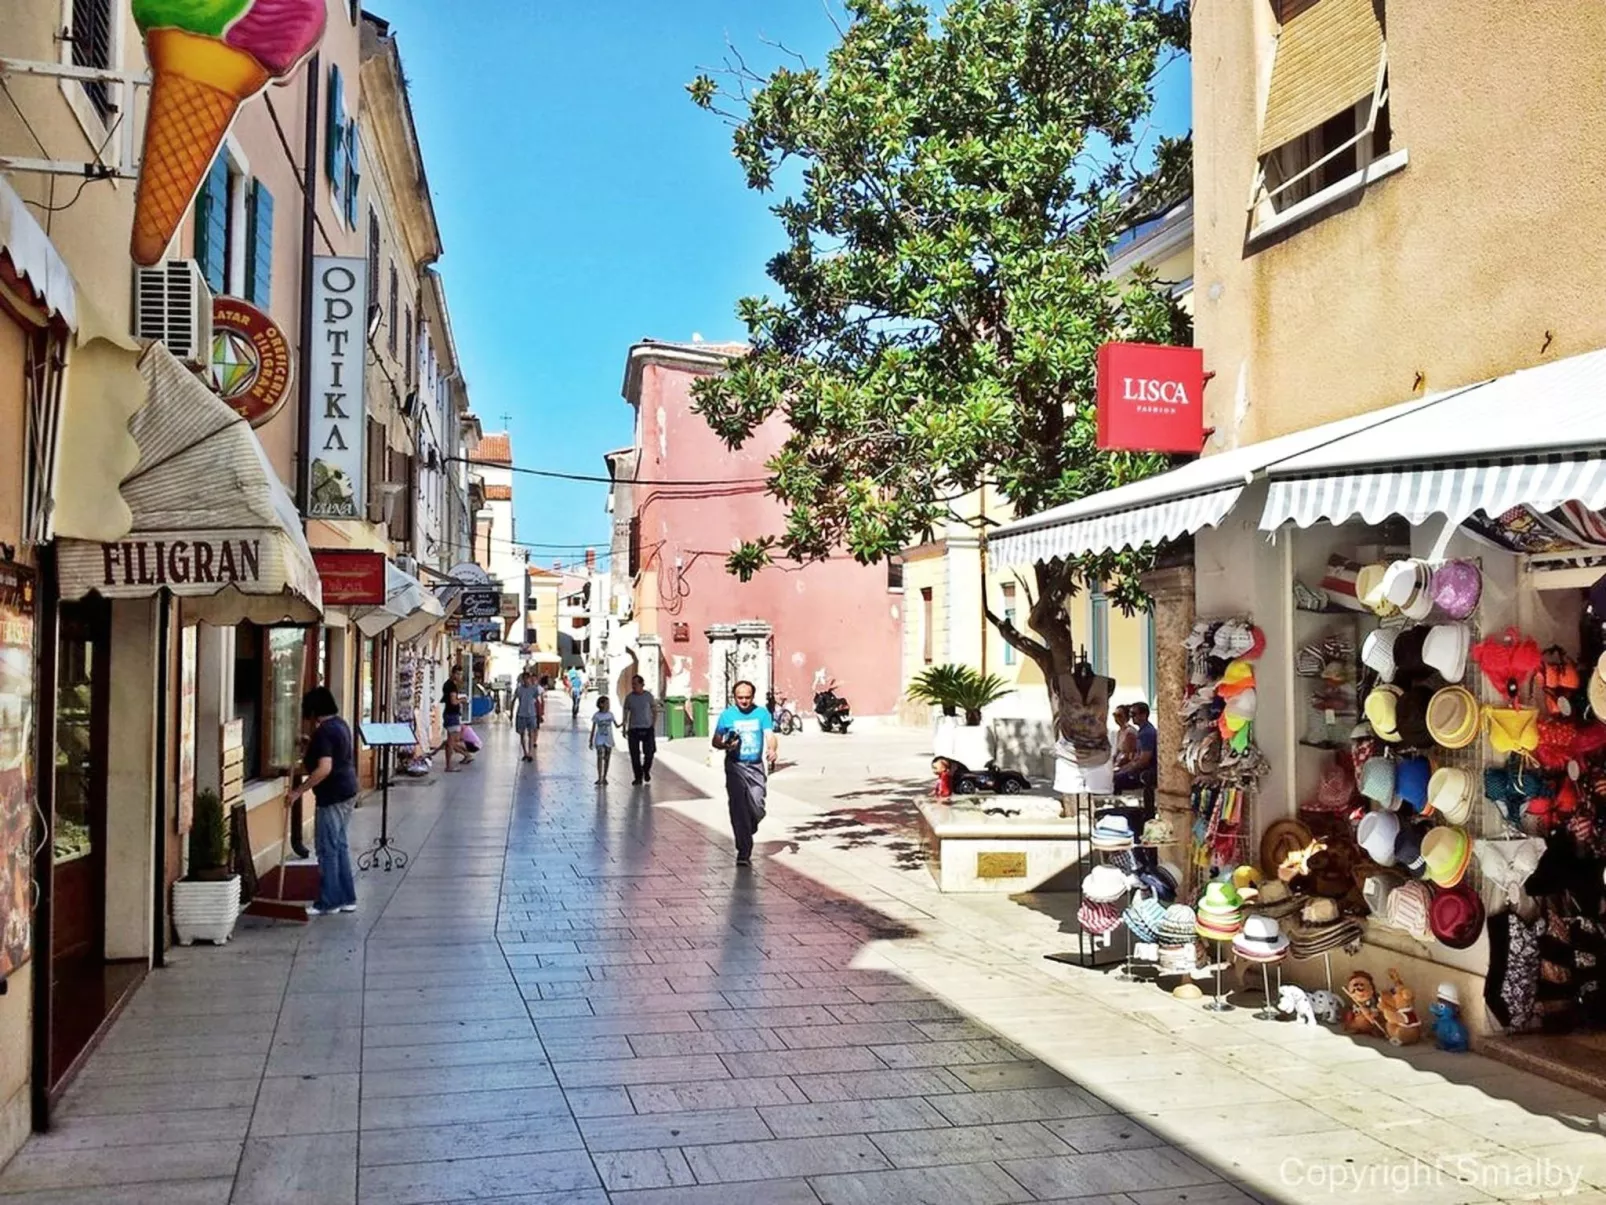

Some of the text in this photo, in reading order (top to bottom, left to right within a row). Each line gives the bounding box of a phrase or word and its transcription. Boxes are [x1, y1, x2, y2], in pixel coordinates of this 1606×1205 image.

[213, 310, 252, 326] ATAR
[252, 332, 274, 398] FILIGRAN
[265, 327, 289, 405] OREFICERIA
[322, 266, 356, 451] OPTIKA
[1123, 377, 1189, 404] LISCA
[1136, 405, 1176, 414] FASHION
[312, 502, 352, 516] LUNA
[102, 539, 261, 586] FILIGRAN
